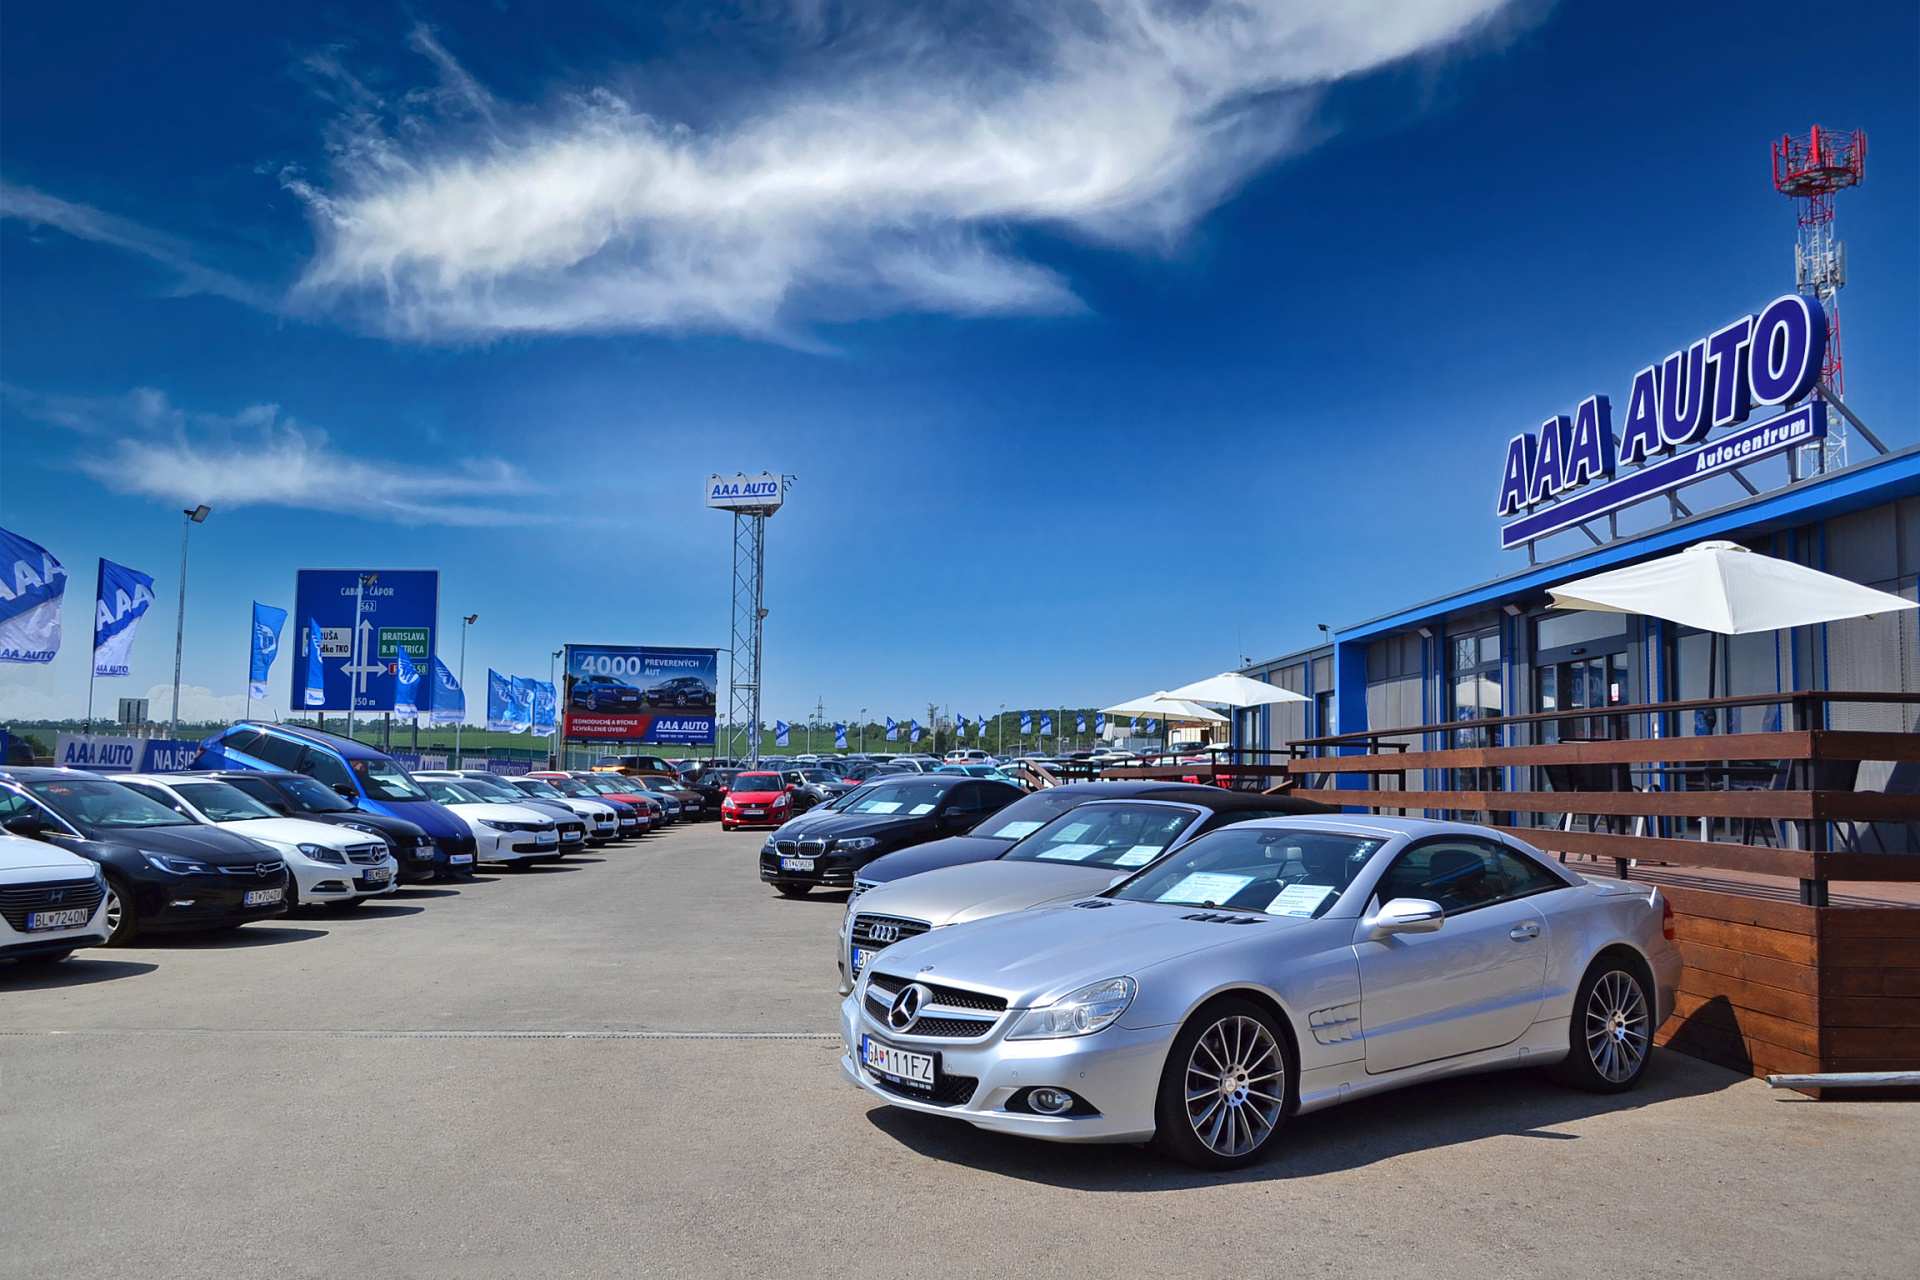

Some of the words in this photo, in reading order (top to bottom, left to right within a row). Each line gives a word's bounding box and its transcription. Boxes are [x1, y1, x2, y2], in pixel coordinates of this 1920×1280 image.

[1497, 394, 1606, 516] AAA
[1618, 294, 1814, 466] AUTO
[1695, 416, 1807, 473] Autocentrum
[711, 484, 740, 496] AAA
[743, 482, 778, 495] AUTO
[96, 583, 155, 632] AAA
[360, 602, 375, 611] 562
[382, 632, 425, 641] BRATISLAVA
[335, 645, 349, 653] TKO
[382, 645, 424, 654] B.BYTRICA
[22, 650, 56, 660] AUTO
[95, 664, 108, 674] AAA
[108, 664, 129, 674] AUTO
[580, 655, 641, 676] 4000
[644, 658, 699, 668] PREVERENÝCH
[656, 720, 679, 730] AAA
[680, 720, 710, 731] AUTO
[64, 742, 96, 764] AAA
[98, 743, 134, 766] AUTO
